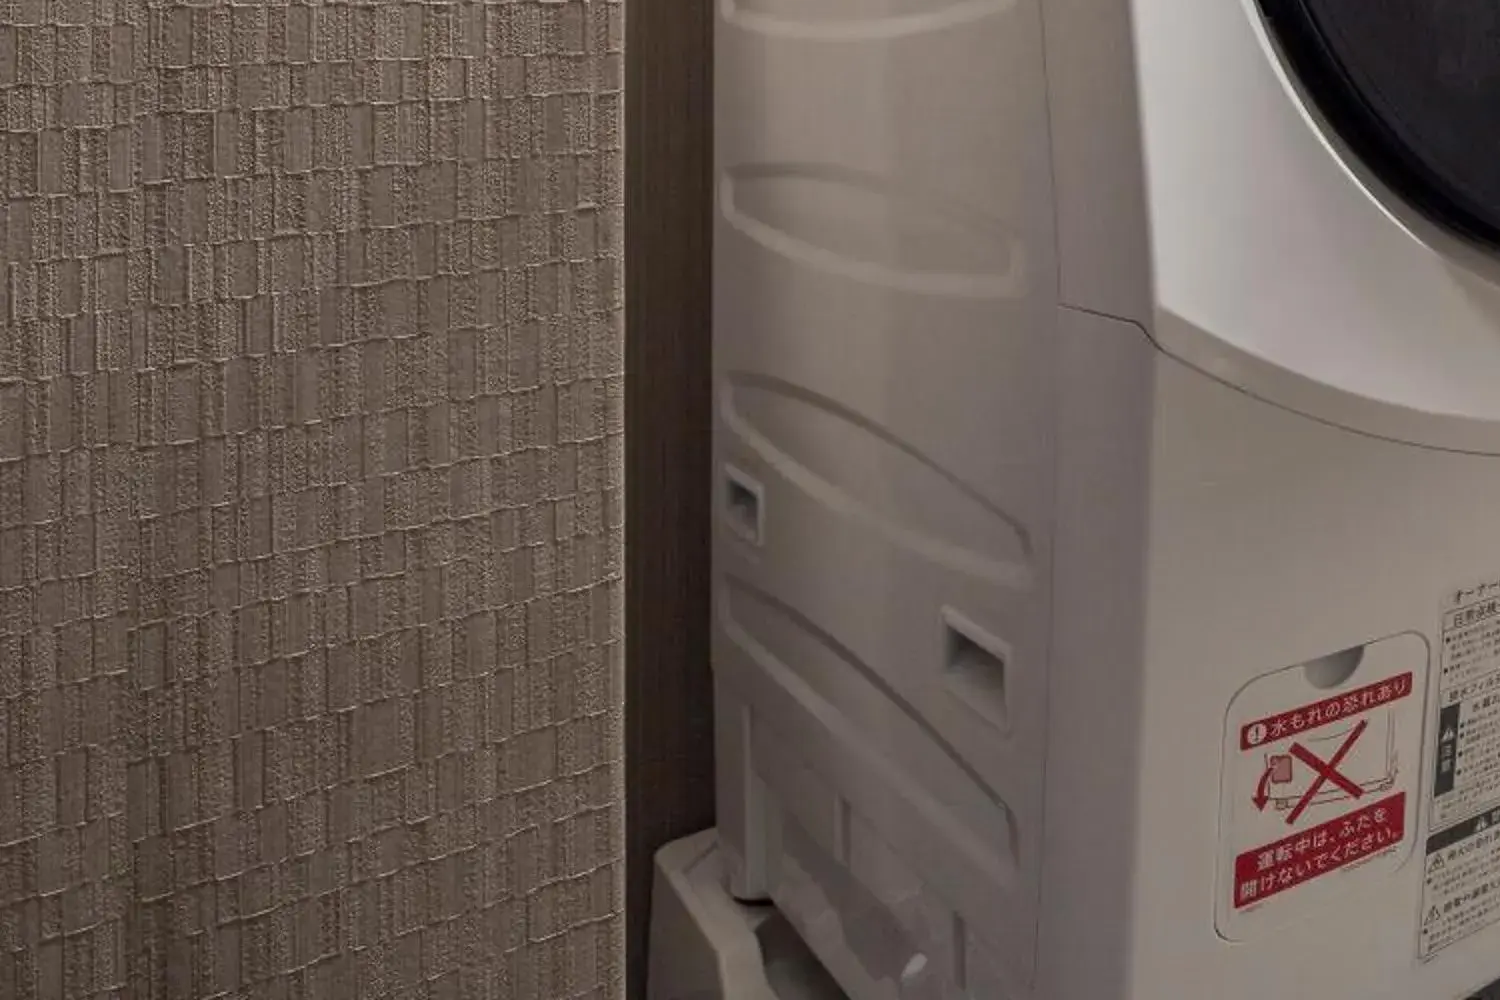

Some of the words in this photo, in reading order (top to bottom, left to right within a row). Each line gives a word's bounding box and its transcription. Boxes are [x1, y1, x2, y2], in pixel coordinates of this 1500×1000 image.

[1270, 682, 1406, 736] 水もれの恐れあり
[1240, 828, 1400, 898] 開けないでください。
[1257, 807, 1388, 871] 運転中は、ふたを
